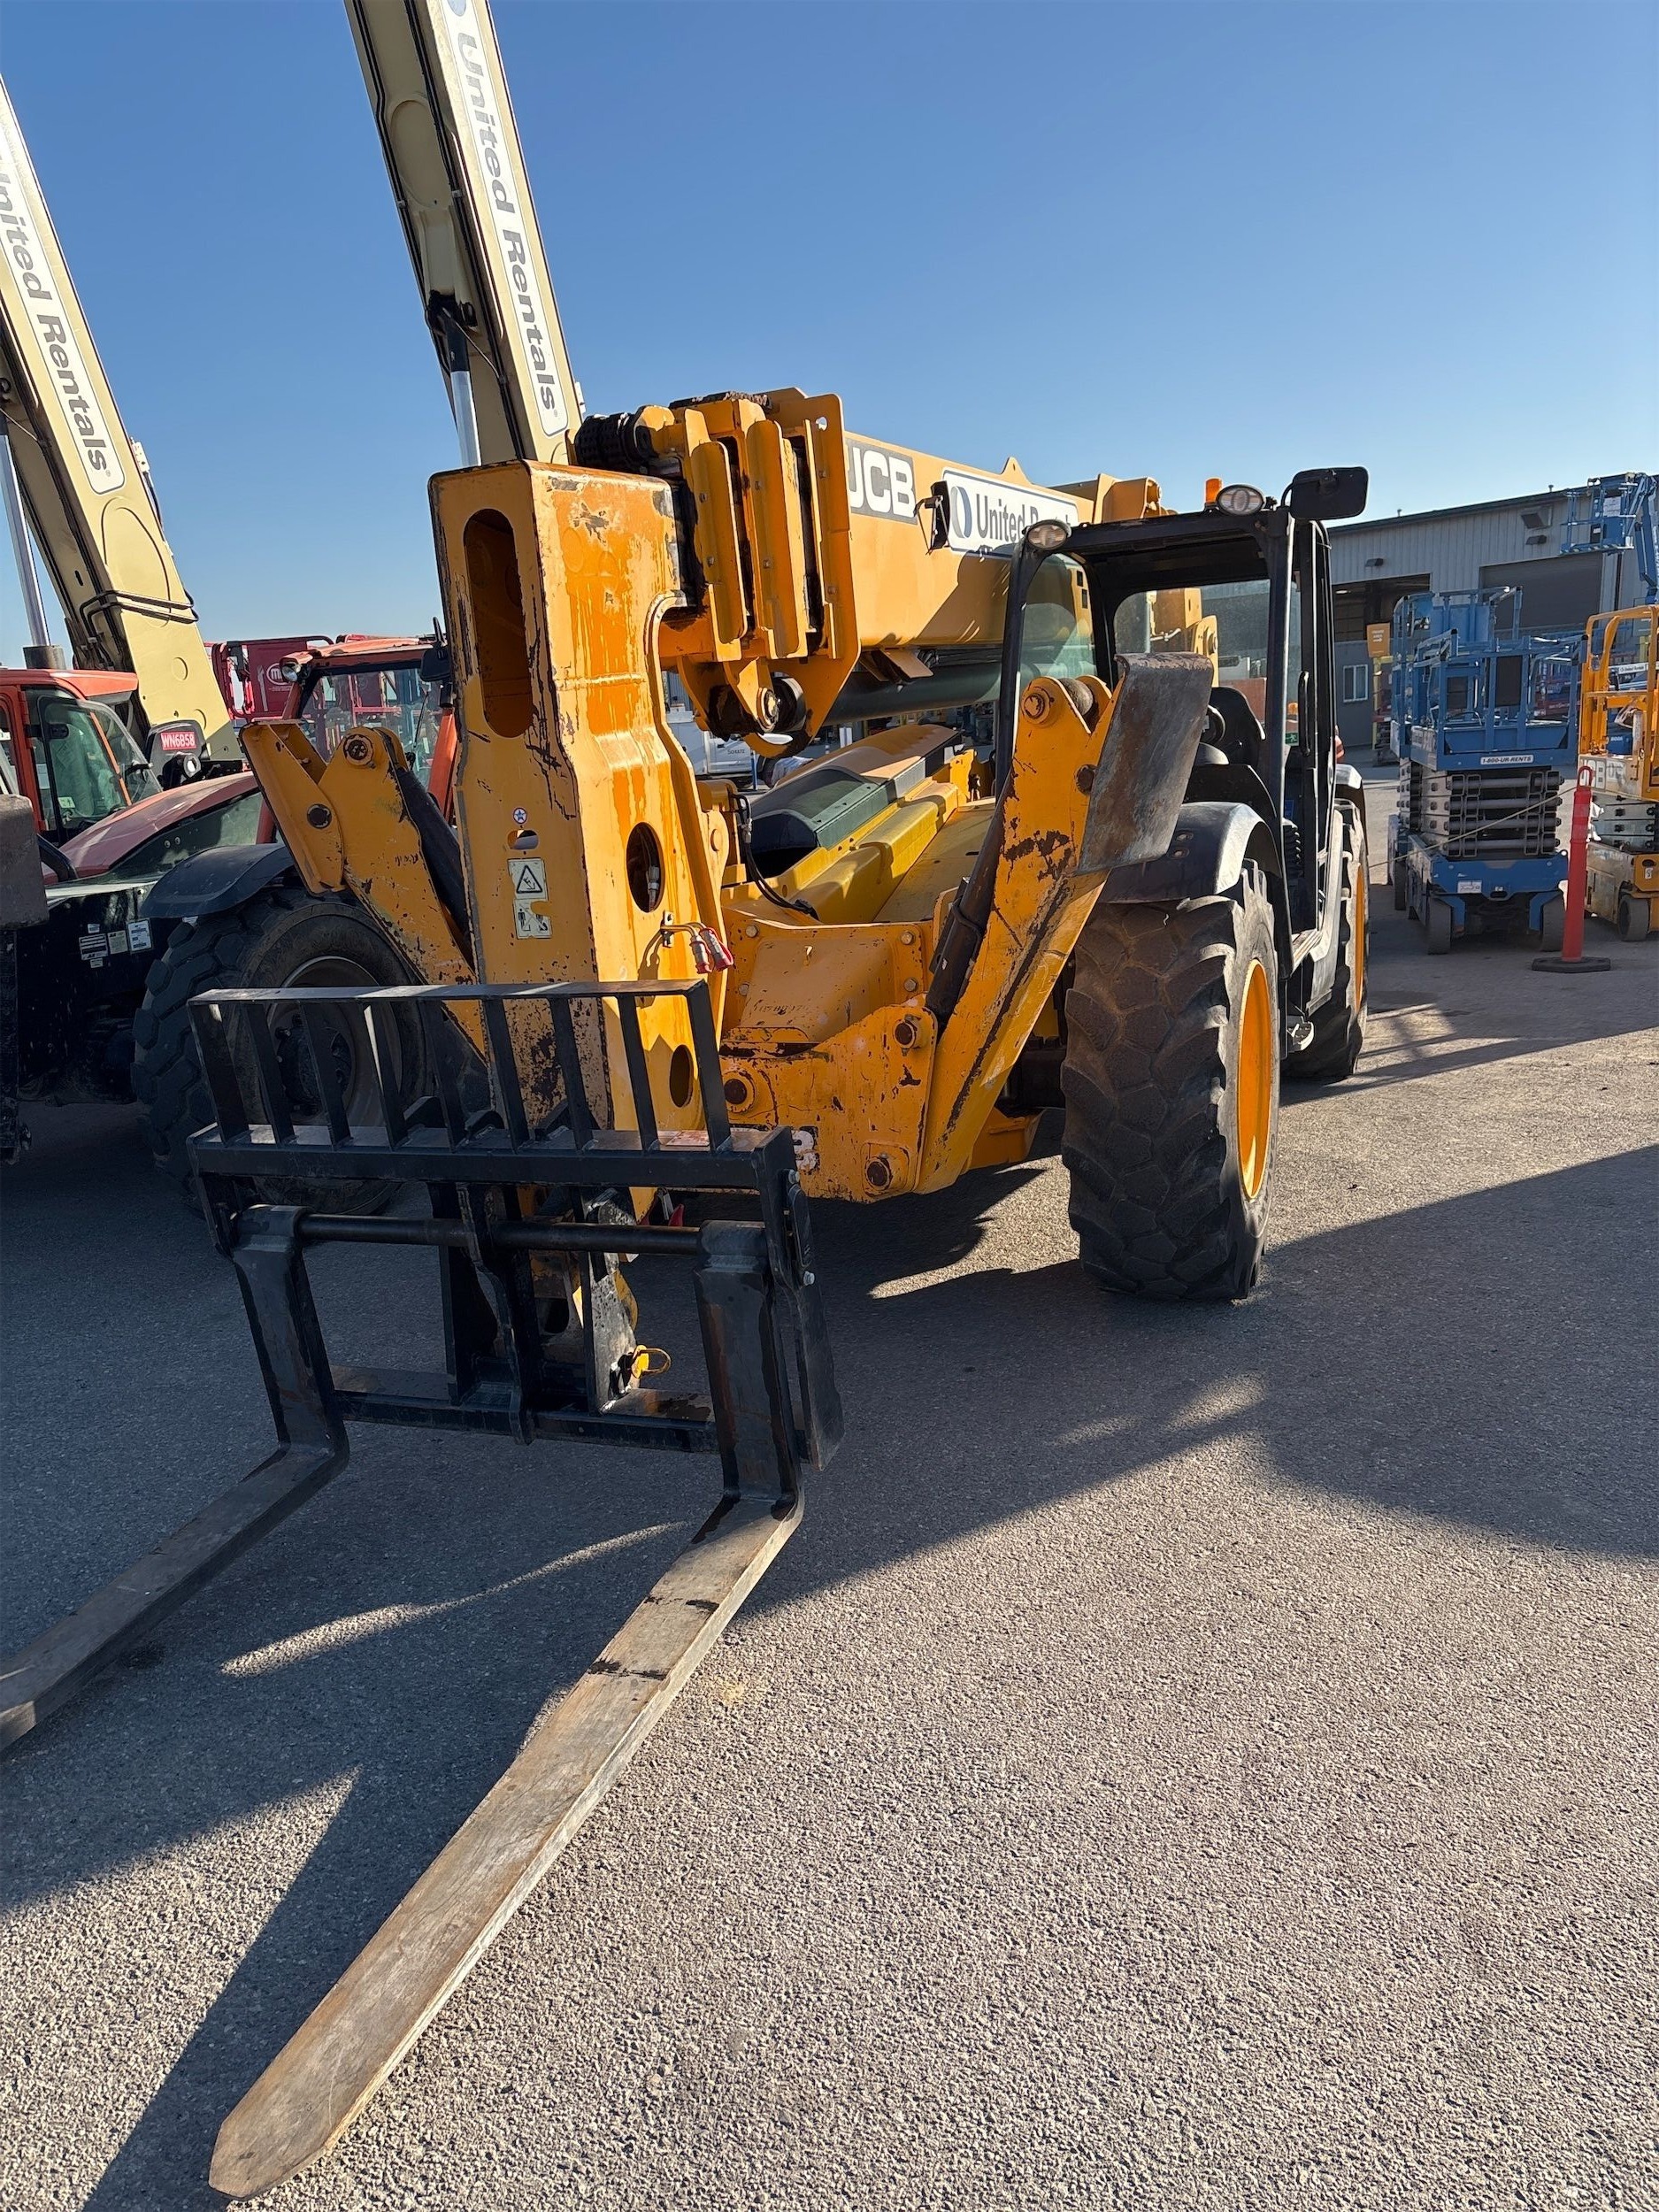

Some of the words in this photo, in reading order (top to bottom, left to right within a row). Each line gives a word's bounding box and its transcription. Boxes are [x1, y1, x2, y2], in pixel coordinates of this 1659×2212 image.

[0, 173, 52, 301] nited
[37, 314, 107, 471] Rentals
[457, 33, 516, 214] United
[503, 229, 556, 411] Rentals
[848, 446, 915, 518] JCB
